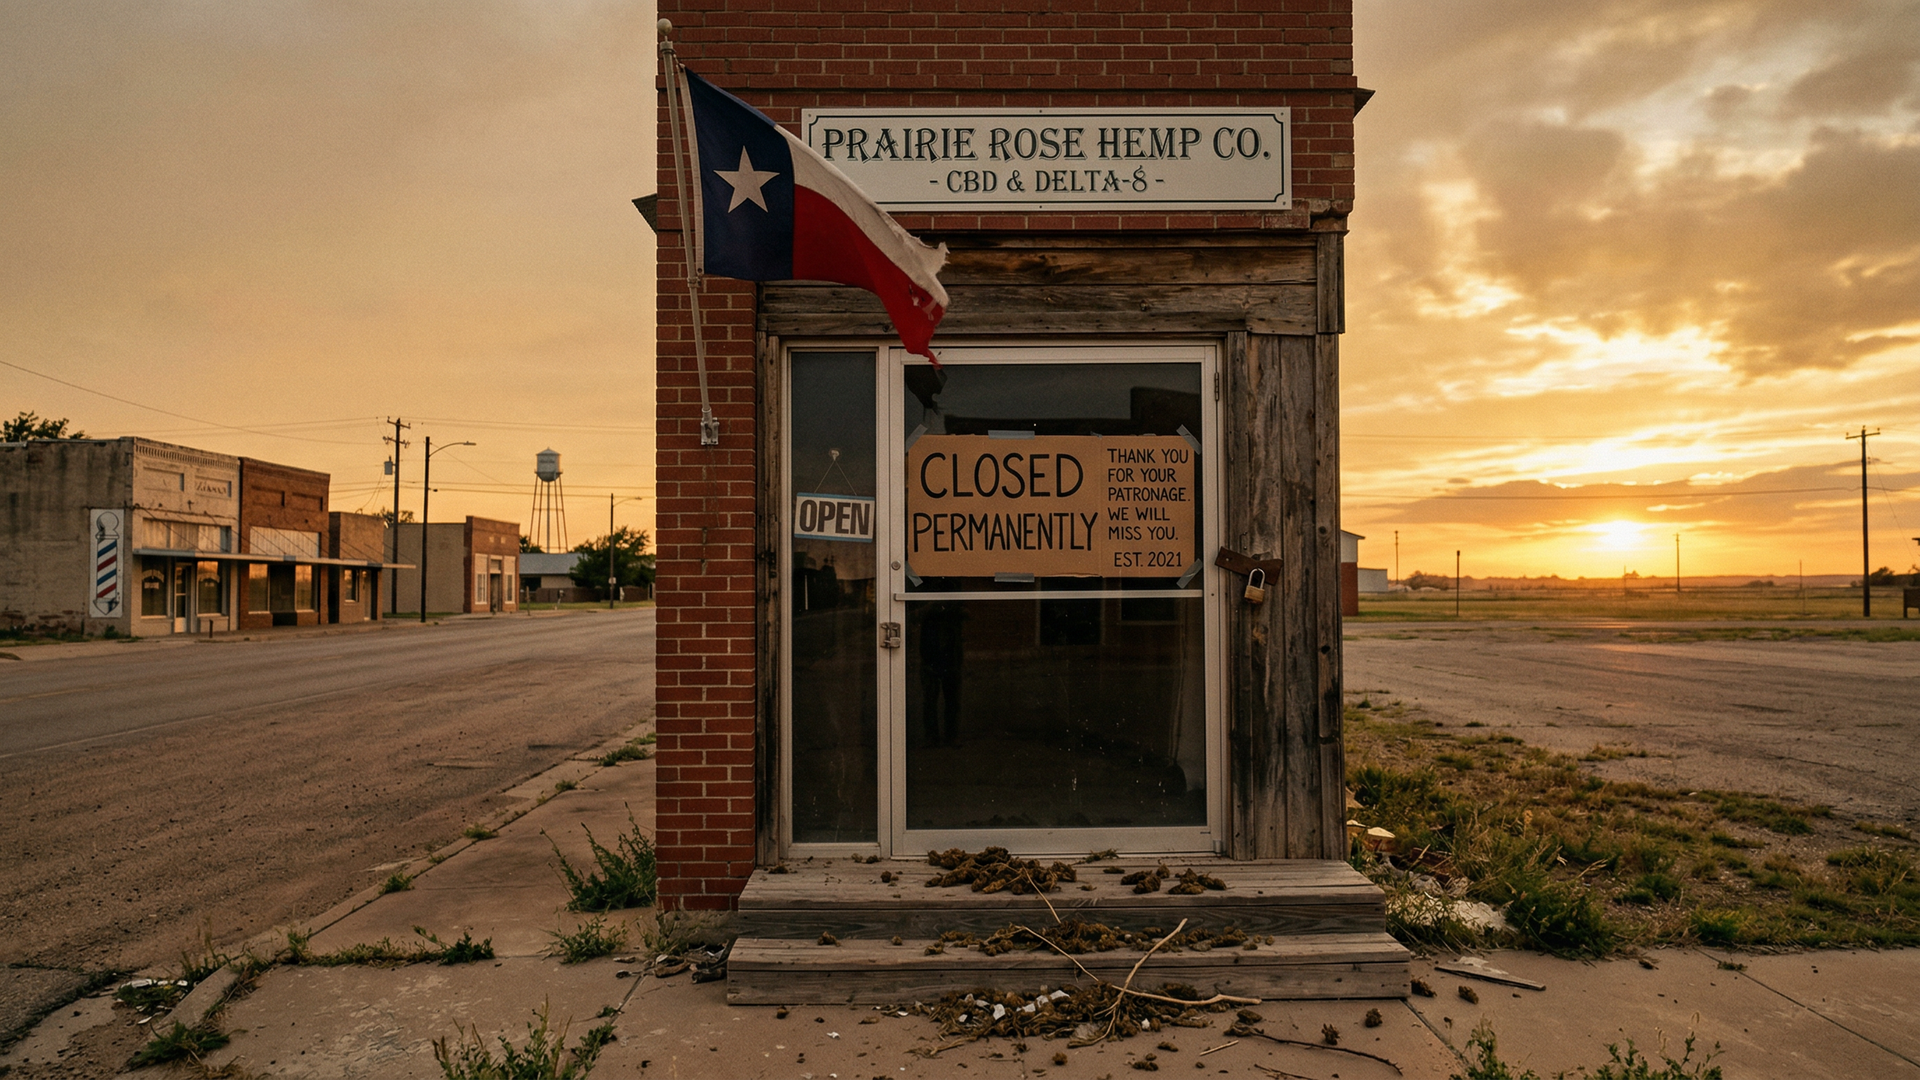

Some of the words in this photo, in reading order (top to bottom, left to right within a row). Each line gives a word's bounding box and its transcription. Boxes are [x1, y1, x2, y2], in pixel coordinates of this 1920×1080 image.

[822, 127, 977, 162] PRAIRIE
[989, 126, 1089, 161] ROSE
[1097, 127, 1202, 161] HEMP
[1213, 127, 1272, 160] CO.
[946, 169, 998, 193] CBD
[1006, 169, 1026, 193] &
[1034, 165, 1148, 193] DELTA-8
[1107, 448, 1155, 464] THANK
[1163, 448, 1189, 464] YOU
[920, 452, 1084, 499] CLOSED
[1108, 468, 1135, 483] FOR
[1140, 468, 1177, 483] YOUR
[1108, 487, 1191, 502] PATRONAGE.
[799, 499, 870, 535] OPEN
[1108, 507, 1129, 521] WE
[1135, 507, 1170, 521] WILL
[913, 512, 1099, 553] PERMANENTLY
[1108, 526, 1142, 541] MISS
[1149, 526, 1178, 541] YOU.
[1114, 552, 1144, 568] EST.
[1147, 552, 1183, 568] 2021
